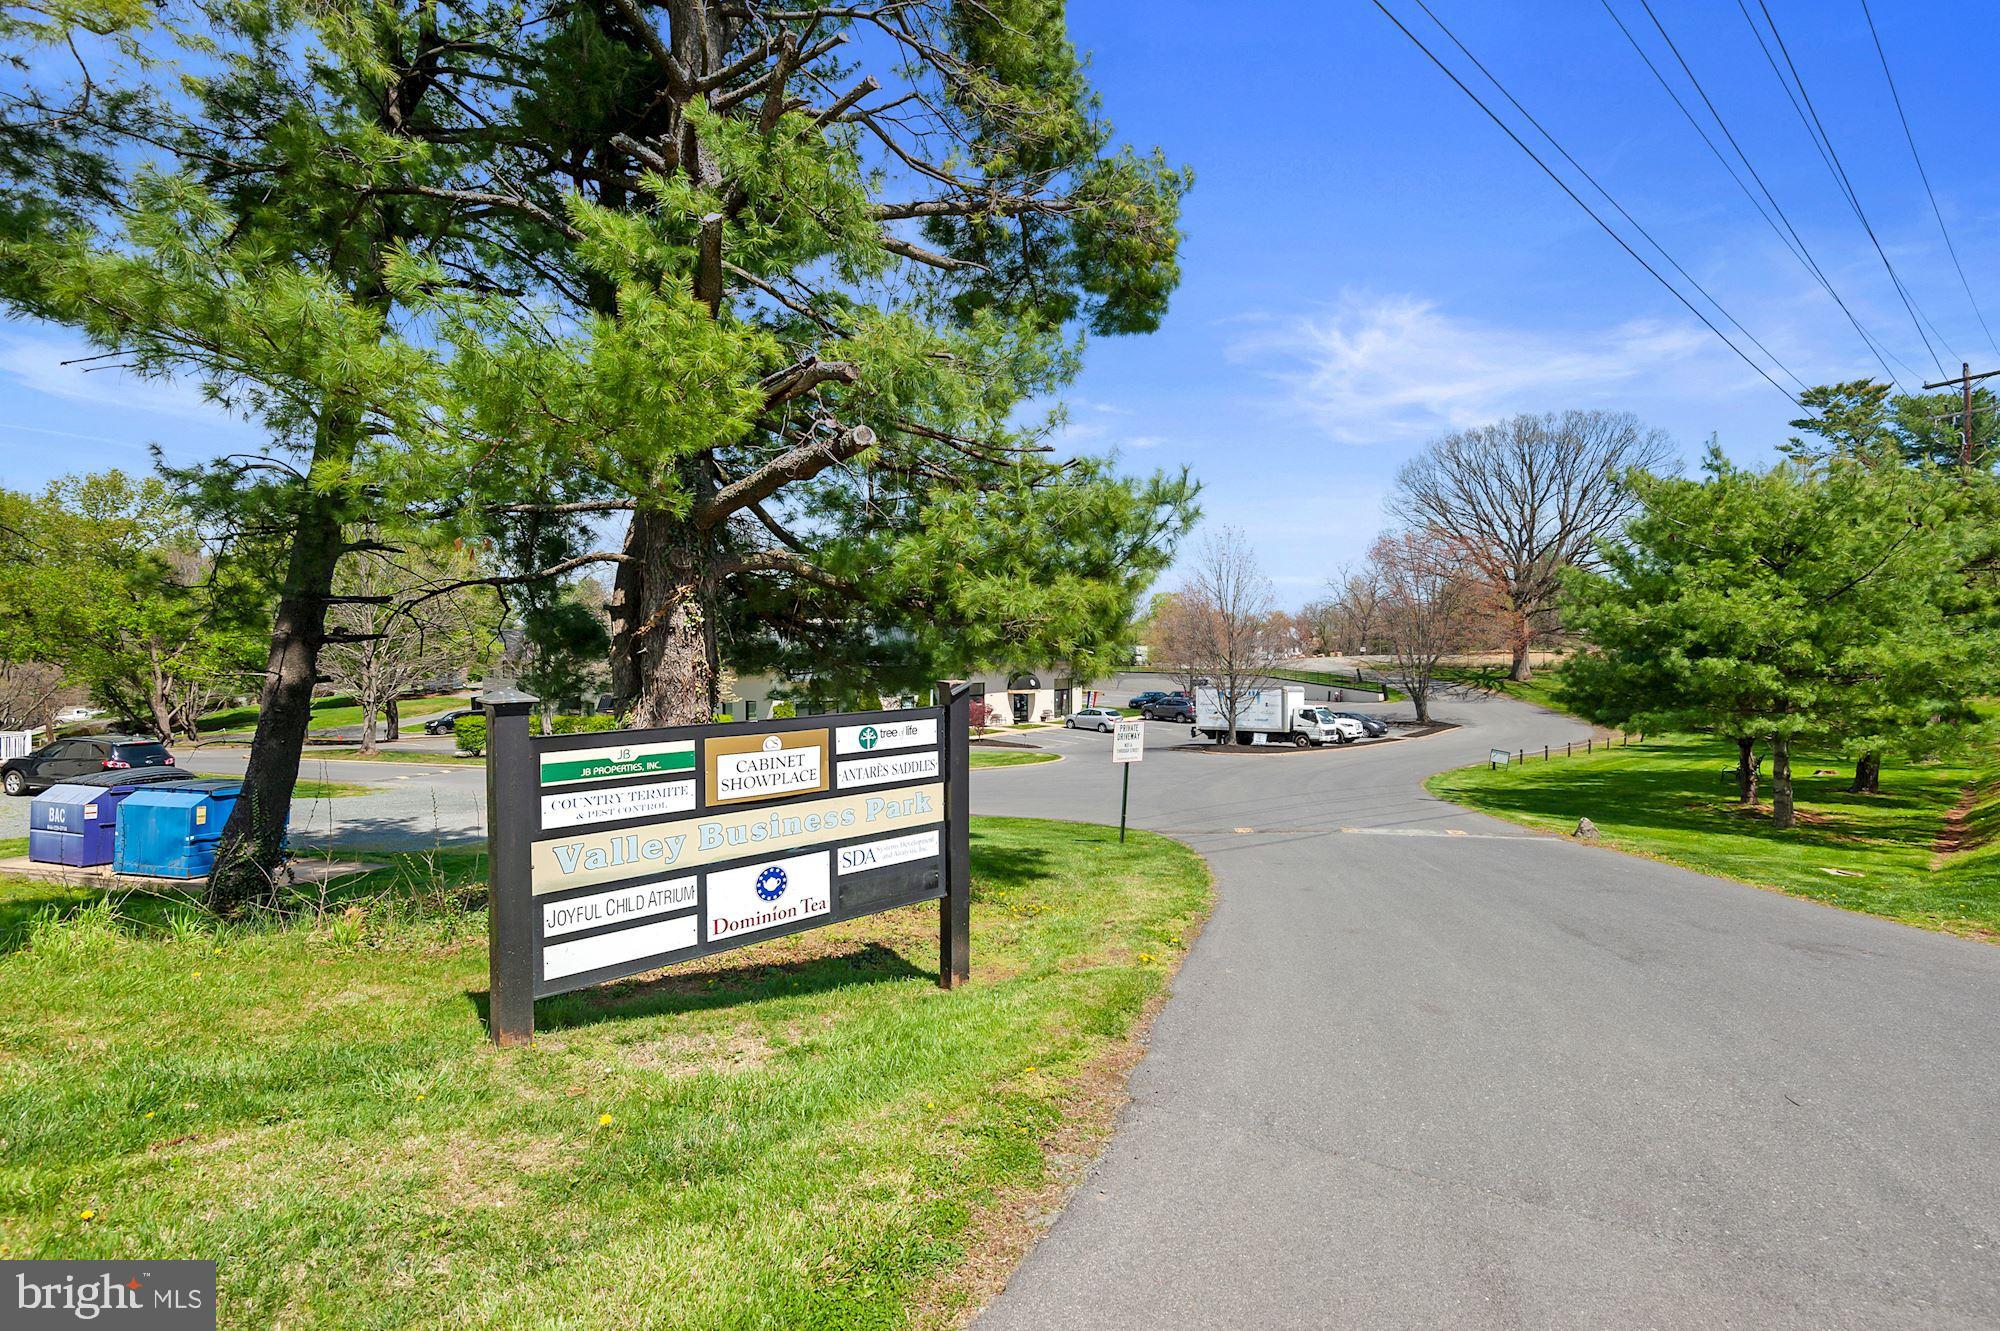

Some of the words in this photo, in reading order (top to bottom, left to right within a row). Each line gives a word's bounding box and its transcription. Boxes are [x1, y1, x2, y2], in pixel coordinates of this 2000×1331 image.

[880, 728, 898, 739] tree
[905, 725, 918, 736] life
[1120, 724, 1139, 732] PRIVATE
[1117, 733, 1140, 741] DRIVEWAY
[617, 749, 631, 760] JB
[580, 768, 592, 777] JB
[593, 763, 645, 776] PROPERTIES,
[646, 761, 662, 770] INC.
[736, 754, 806, 773] CABINET
[891, 759, 936, 776] SADDLES
[721, 768, 818, 792] SHOWPLACE
[551, 792, 625, 811] COUNTRY
[627, 785, 689, 802] TERMITE
[49, 807, 66, 823] BAC
[576, 812, 584, 820] &
[588, 808, 616, 818] PEST
[618, 802, 668, 814] CONTROL
[552, 834, 687, 875] Valley
[698, 812, 856, 852] Business
[865, 791, 934, 822] Park
[876, 843, 899, 852] Systems
[900, 836, 935, 848] Development
[842, 848, 877, 869] SDA
[547, 904, 603, 928] JOYFUL
[606, 895, 644, 916] CHILD
[648, 885, 695, 908] ATRIUM
[713, 905, 797, 935] Dominion
[800, 898, 827, 913] Tea
